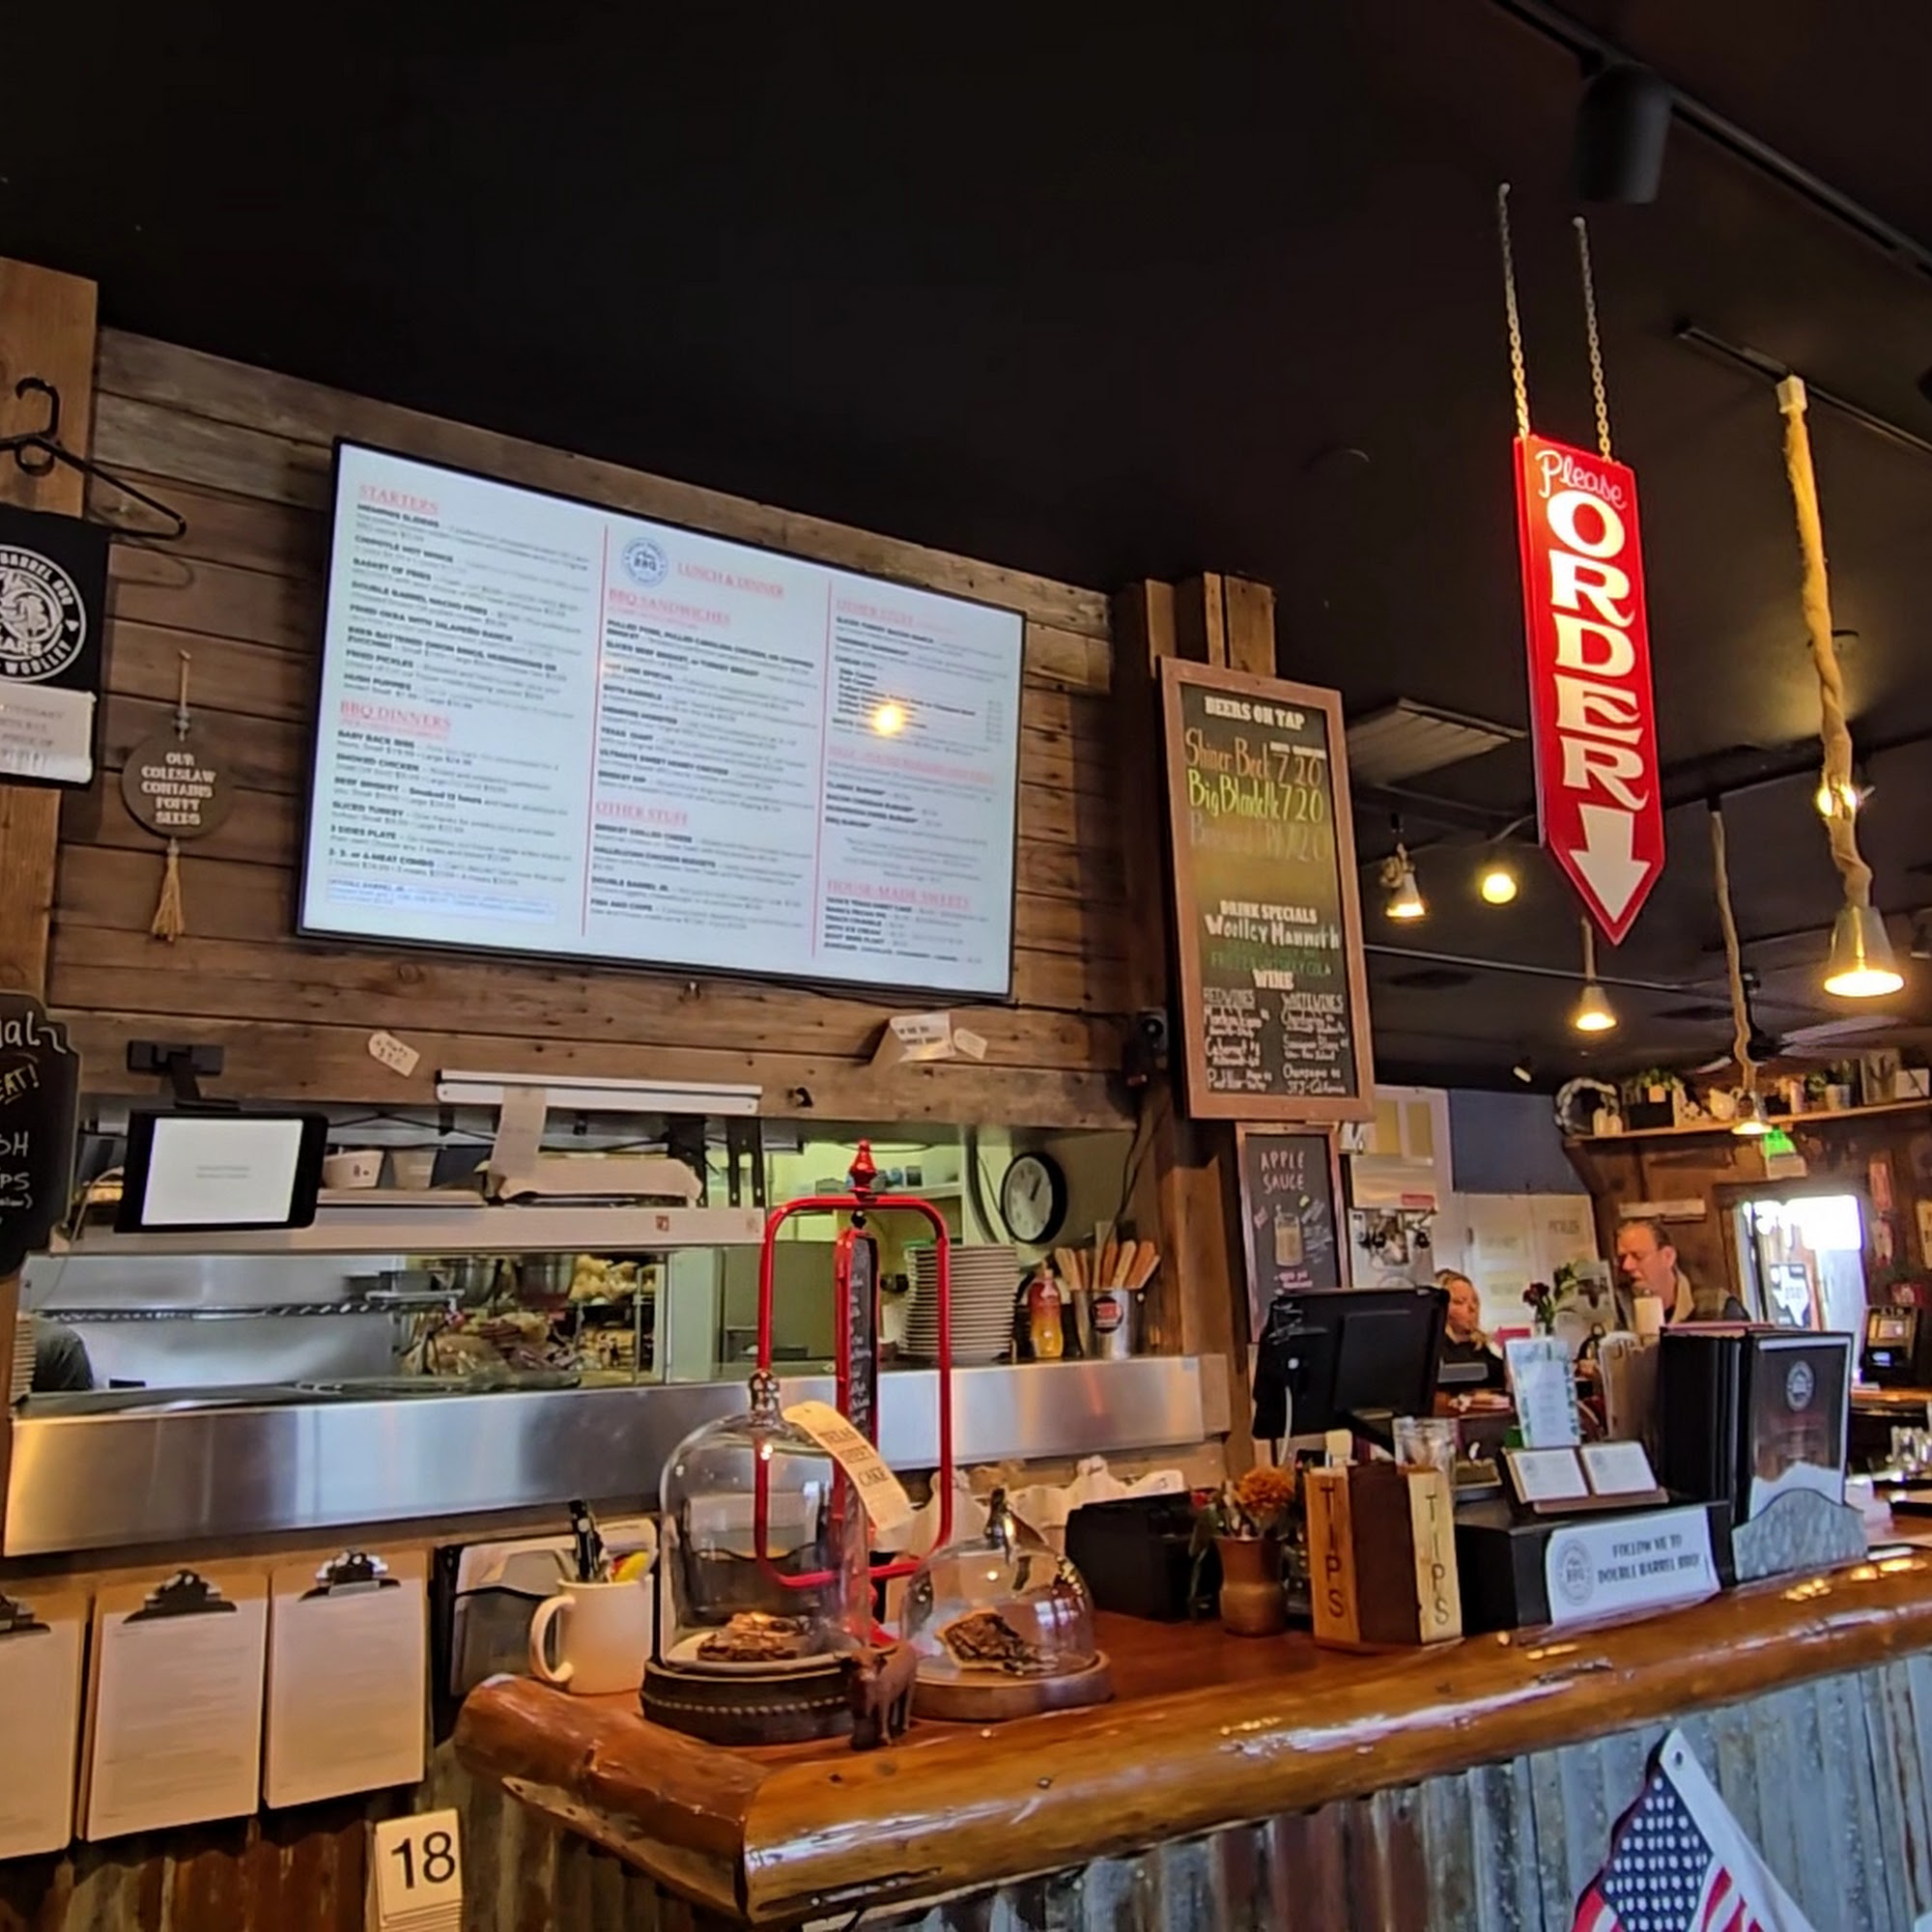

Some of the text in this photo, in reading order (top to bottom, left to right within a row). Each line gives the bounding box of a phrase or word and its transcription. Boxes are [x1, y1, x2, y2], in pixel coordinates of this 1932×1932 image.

[1535, 449, 1627, 509] Please
[360, 485, 439, 515] STARTERS
[0, 552, 74, 606] BARREL BBQ
[609, 589, 729, 624] BBQ SANDWICHES
[5, 639, 72, 675] WOOLLEY
[1547, 490, 1650, 810] ORDER
[340, 701, 451, 730] BBQ DINNERS
[1205, 696, 1305, 730] BEERS ON TAP
[165, 752, 195, 766] OUR
[140, 766, 216, 783] COLESLAW
[140, 781, 213, 799] CONTAINS
[1187, 769, 1219, 816] Big
[1262, 904, 1318, 924] SPECIALS
[1253, 969, 1294, 990] WINE
[1261, 1151, 1305, 1172] APPLE
[1264, 1174, 1305, 1194] SAUCE
[1320, 1487, 1345, 1618] TIPS
[1426, 1494, 1449, 1625] TIPS
[1612, 1534, 1683, 1558] FOLLOW ME TO
[1597, 1565, 1637, 1584] DOUBLE
[1639, 1558, 1675, 1577] BARREL
[391, 1831, 456, 1890] 18
